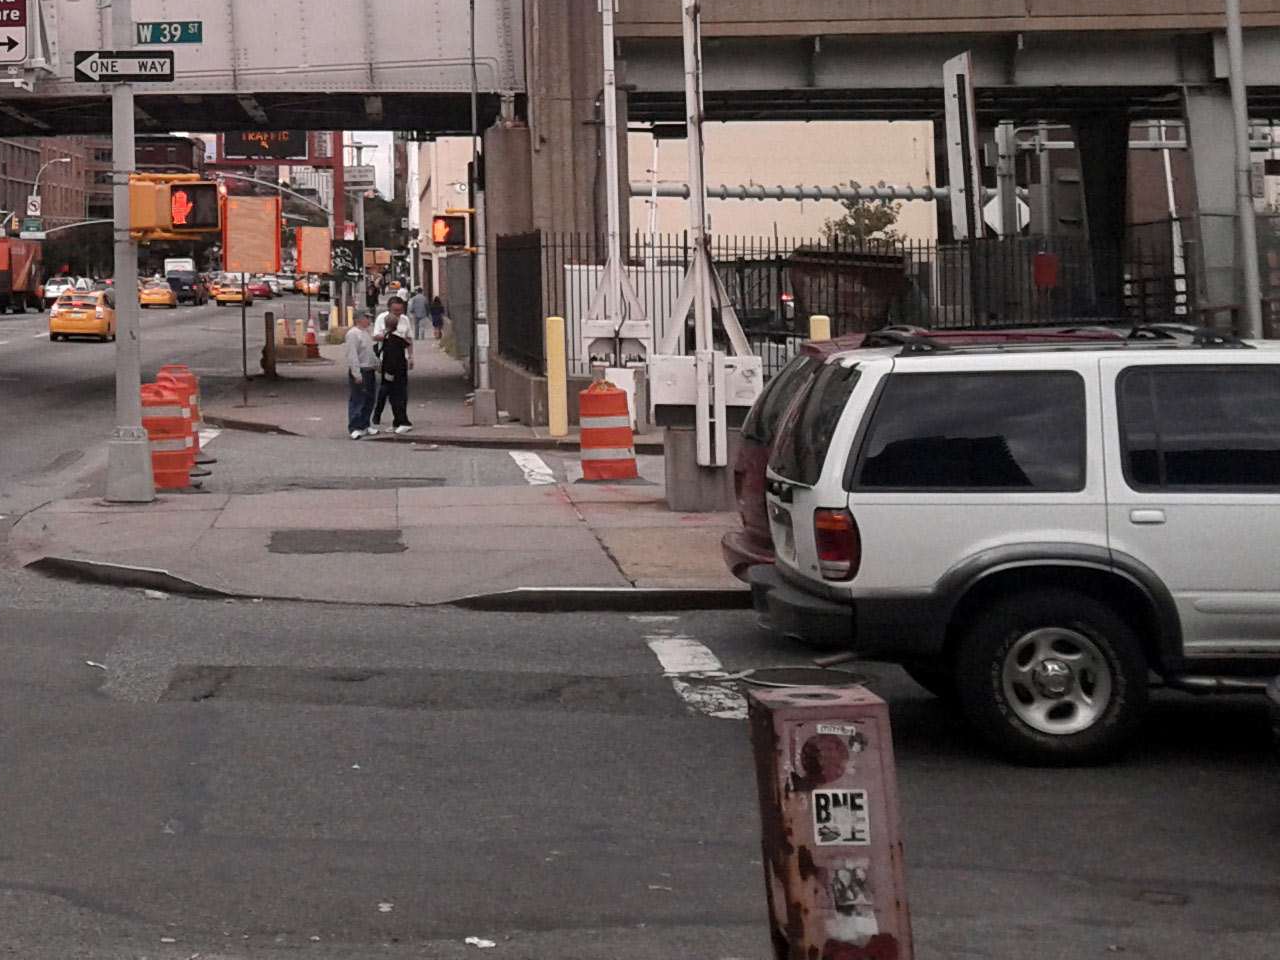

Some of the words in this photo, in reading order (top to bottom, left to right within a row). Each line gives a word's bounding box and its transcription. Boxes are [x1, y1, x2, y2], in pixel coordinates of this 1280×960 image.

[139, 24, 153, 42] W
[159, 23, 181, 42] 39
[188, 23, 199, 33] ST
[89, 61, 119, 73] ONE
[137, 61, 167, 72] WAY
